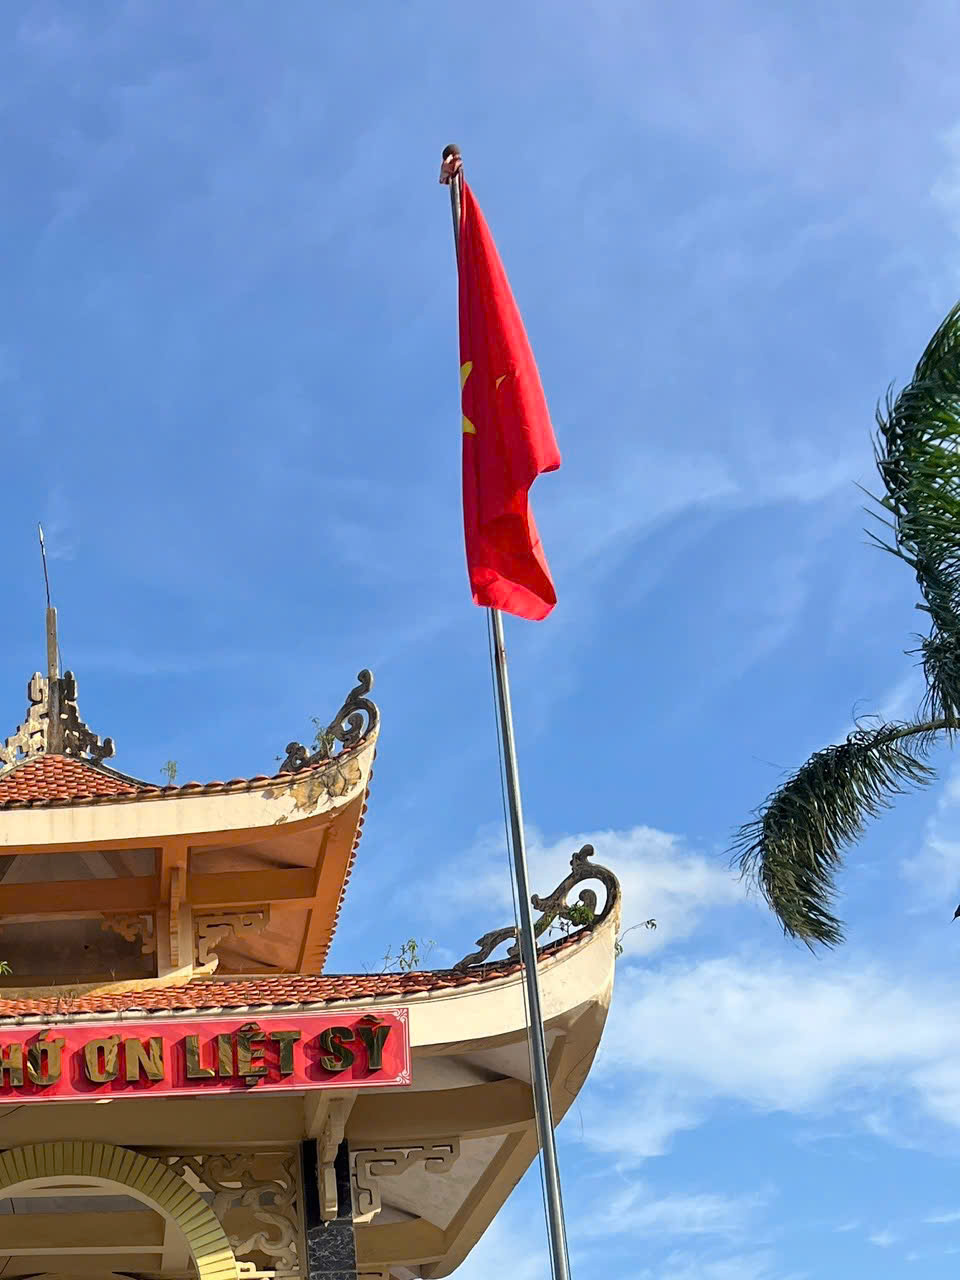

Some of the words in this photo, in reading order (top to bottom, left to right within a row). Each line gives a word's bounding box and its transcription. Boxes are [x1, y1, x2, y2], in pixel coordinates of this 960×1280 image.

[85, 1034, 165, 1083] ƠN
[186, 1022, 301, 1086] LIỆT
[319, 1014, 392, 1072] SỸ
